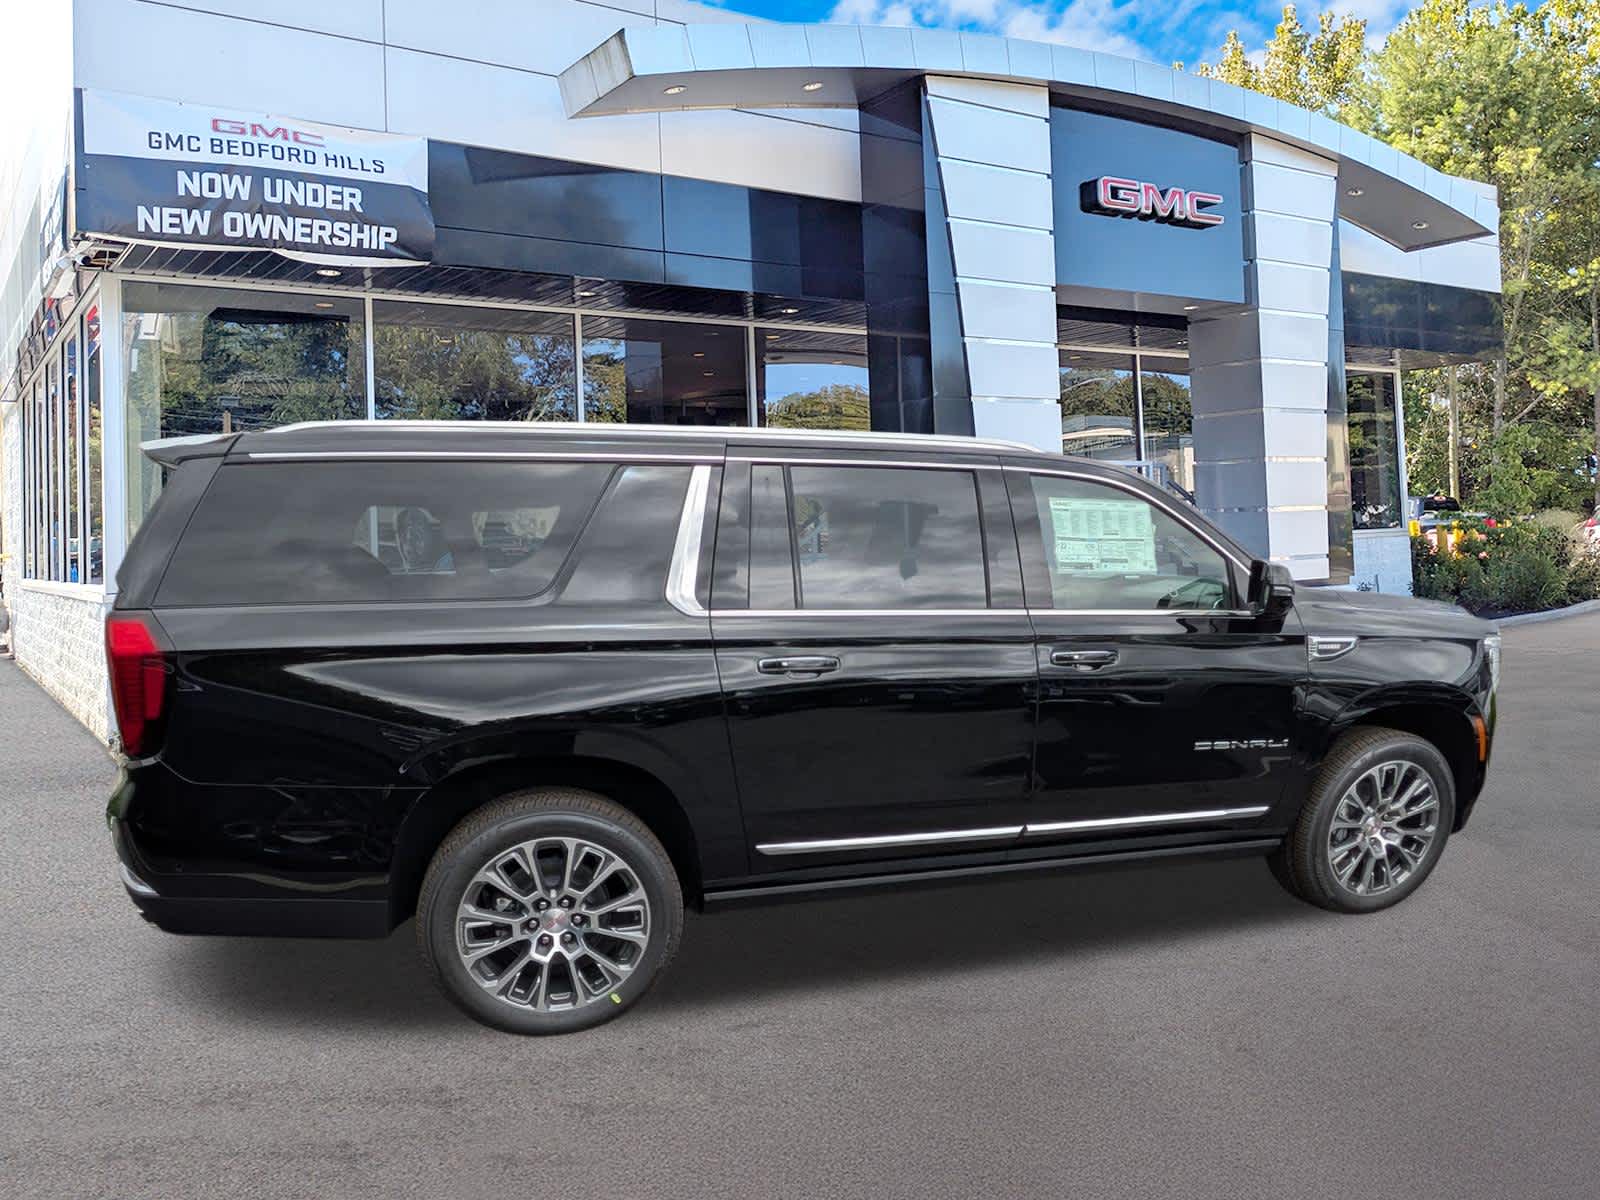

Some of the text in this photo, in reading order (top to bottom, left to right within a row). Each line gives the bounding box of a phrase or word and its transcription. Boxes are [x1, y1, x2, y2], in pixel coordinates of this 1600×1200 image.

[148, 131, 385, 174] GMC BEDFORD HILLS
[211, 117, 325, 147] GMC
[177, 170, 363, 213] NOW UNDER
[1096, 175, 1225, 224] GMC
[137, 205, 398, 250] NEW OWNERSHIP
[1194, 739, 1289, 750] DENALI
